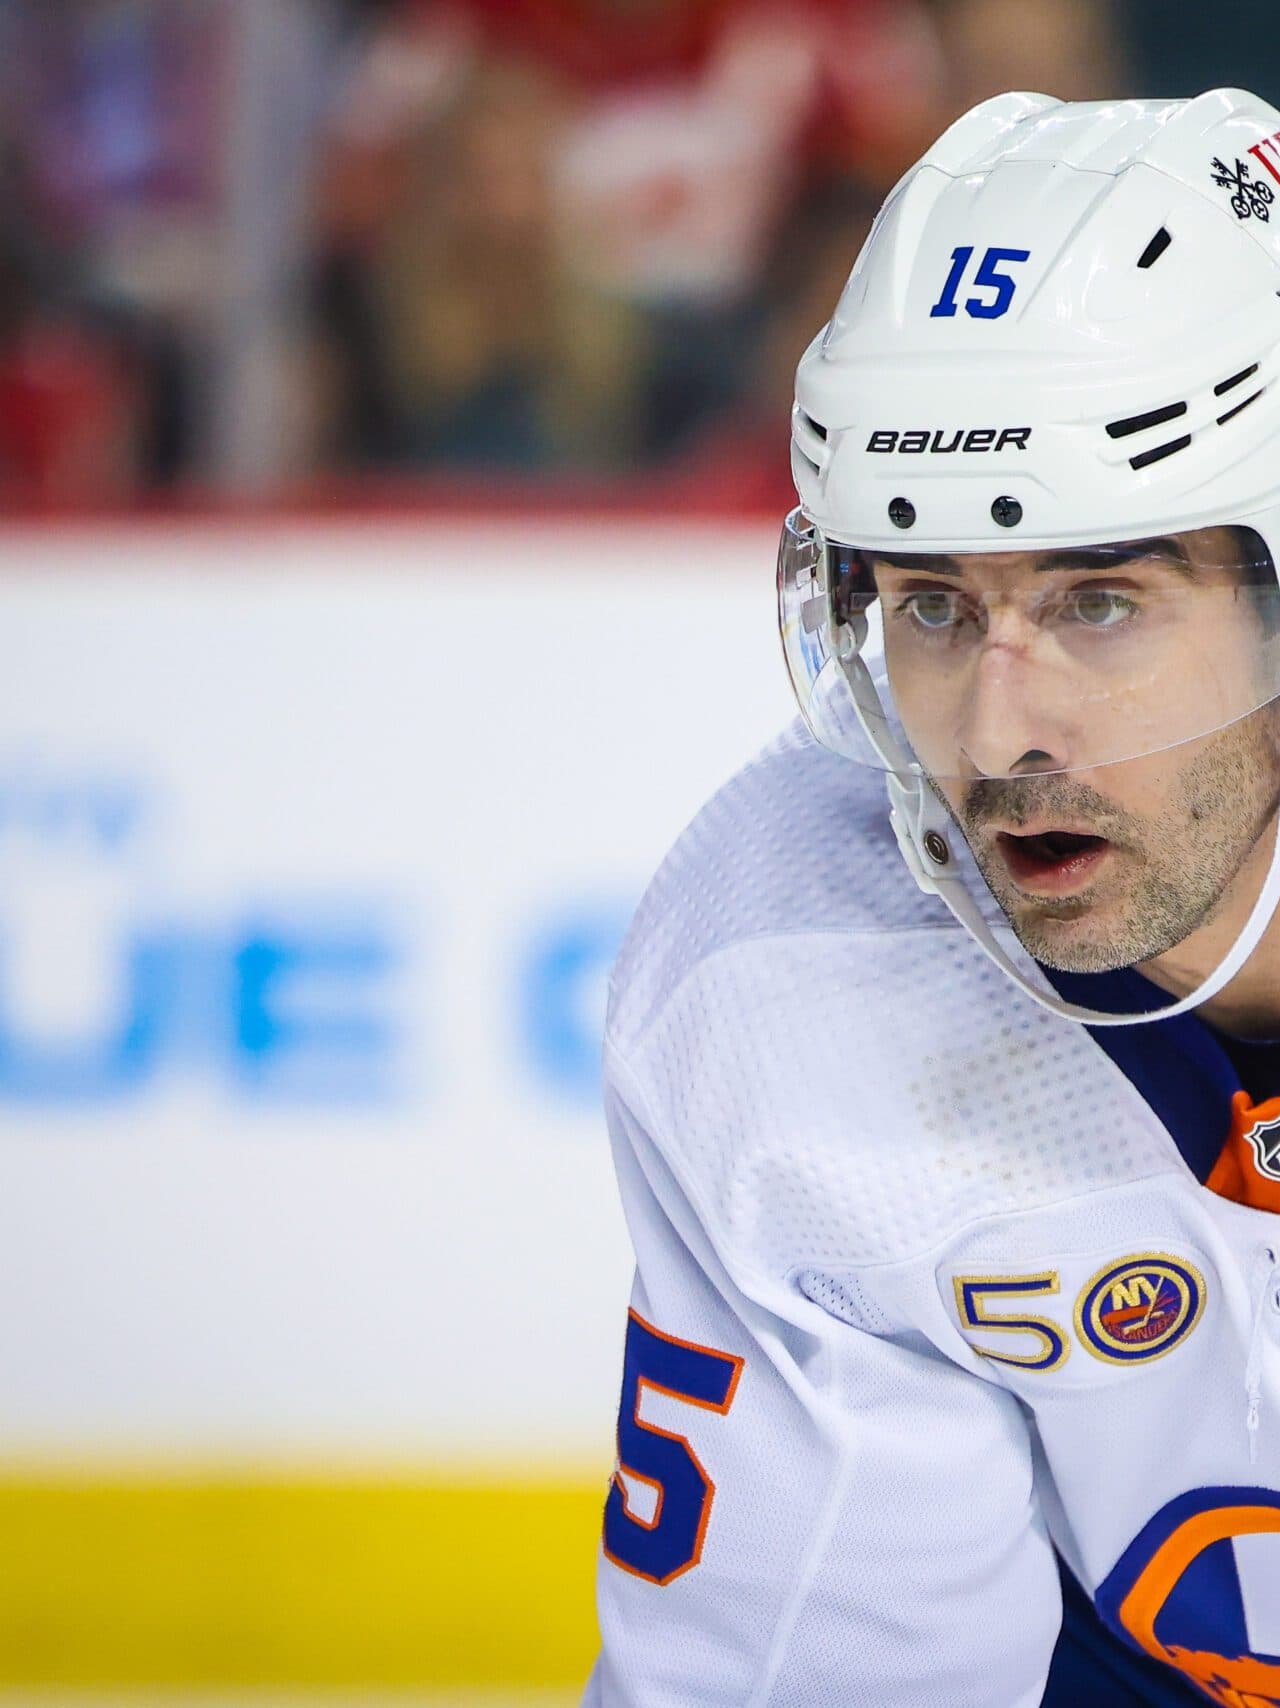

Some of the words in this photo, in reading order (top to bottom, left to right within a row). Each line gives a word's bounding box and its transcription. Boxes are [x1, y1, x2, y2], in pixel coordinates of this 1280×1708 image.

[930, 246, 1031, 320] 15
[865, 427, 1032, 454] BAUER
[602, 1306, 745, 1586] 5
